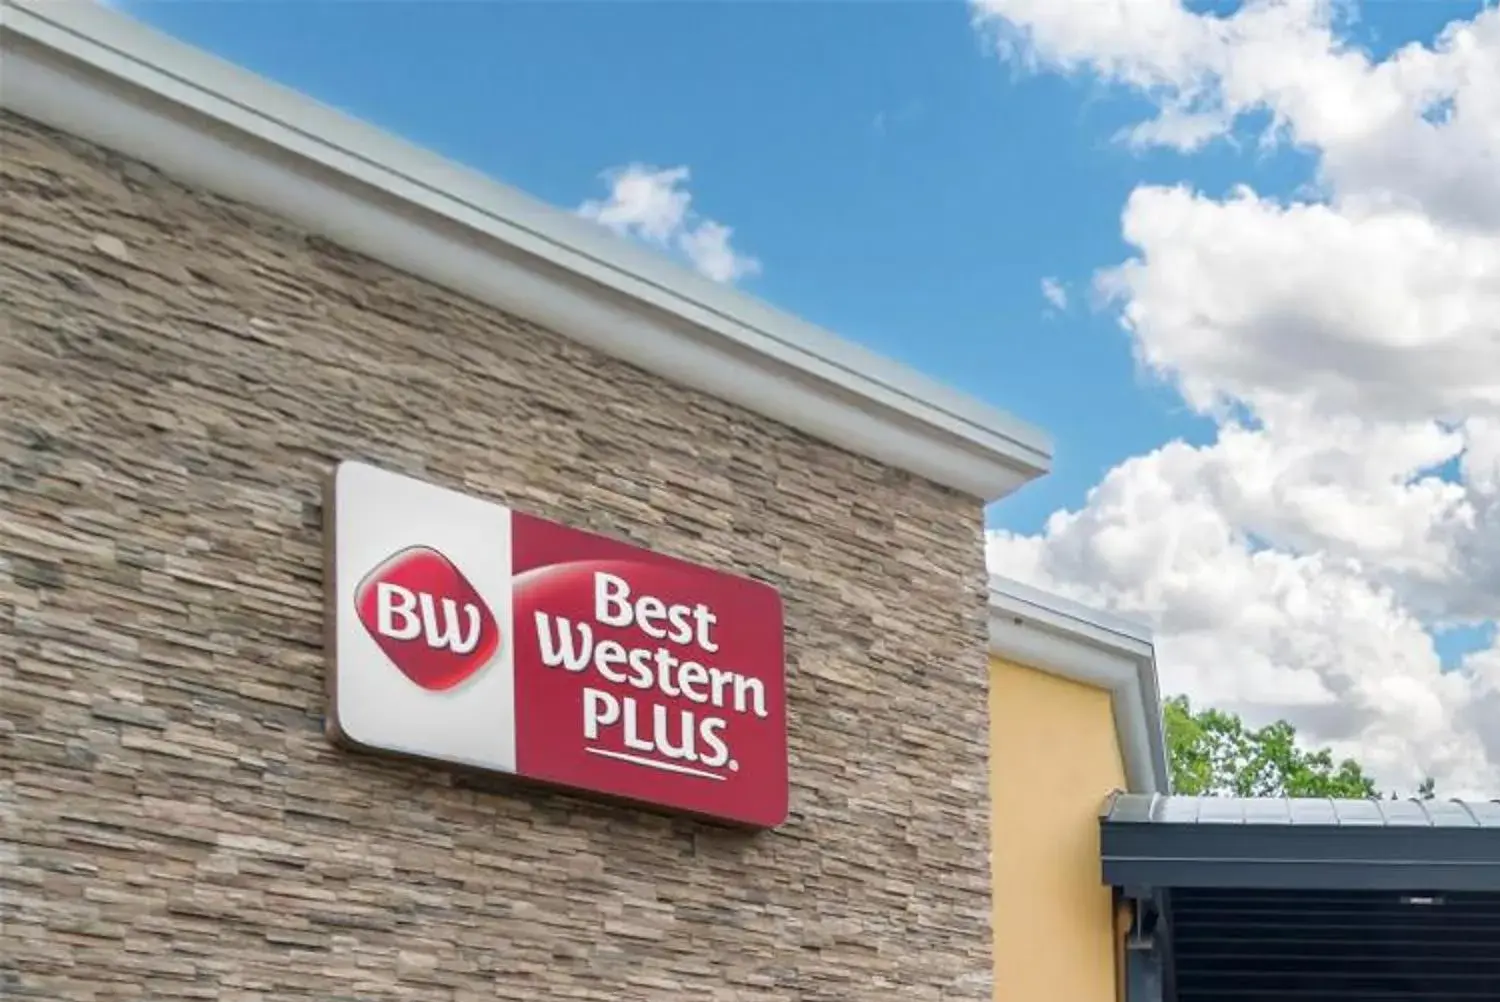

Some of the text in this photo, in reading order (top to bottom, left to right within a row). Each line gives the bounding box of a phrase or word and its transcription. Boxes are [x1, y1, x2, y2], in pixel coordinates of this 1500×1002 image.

[377, 582, 481, 653] BW
[595, 572, 718, 652] Best
[535, 611, 767, 717] Western
